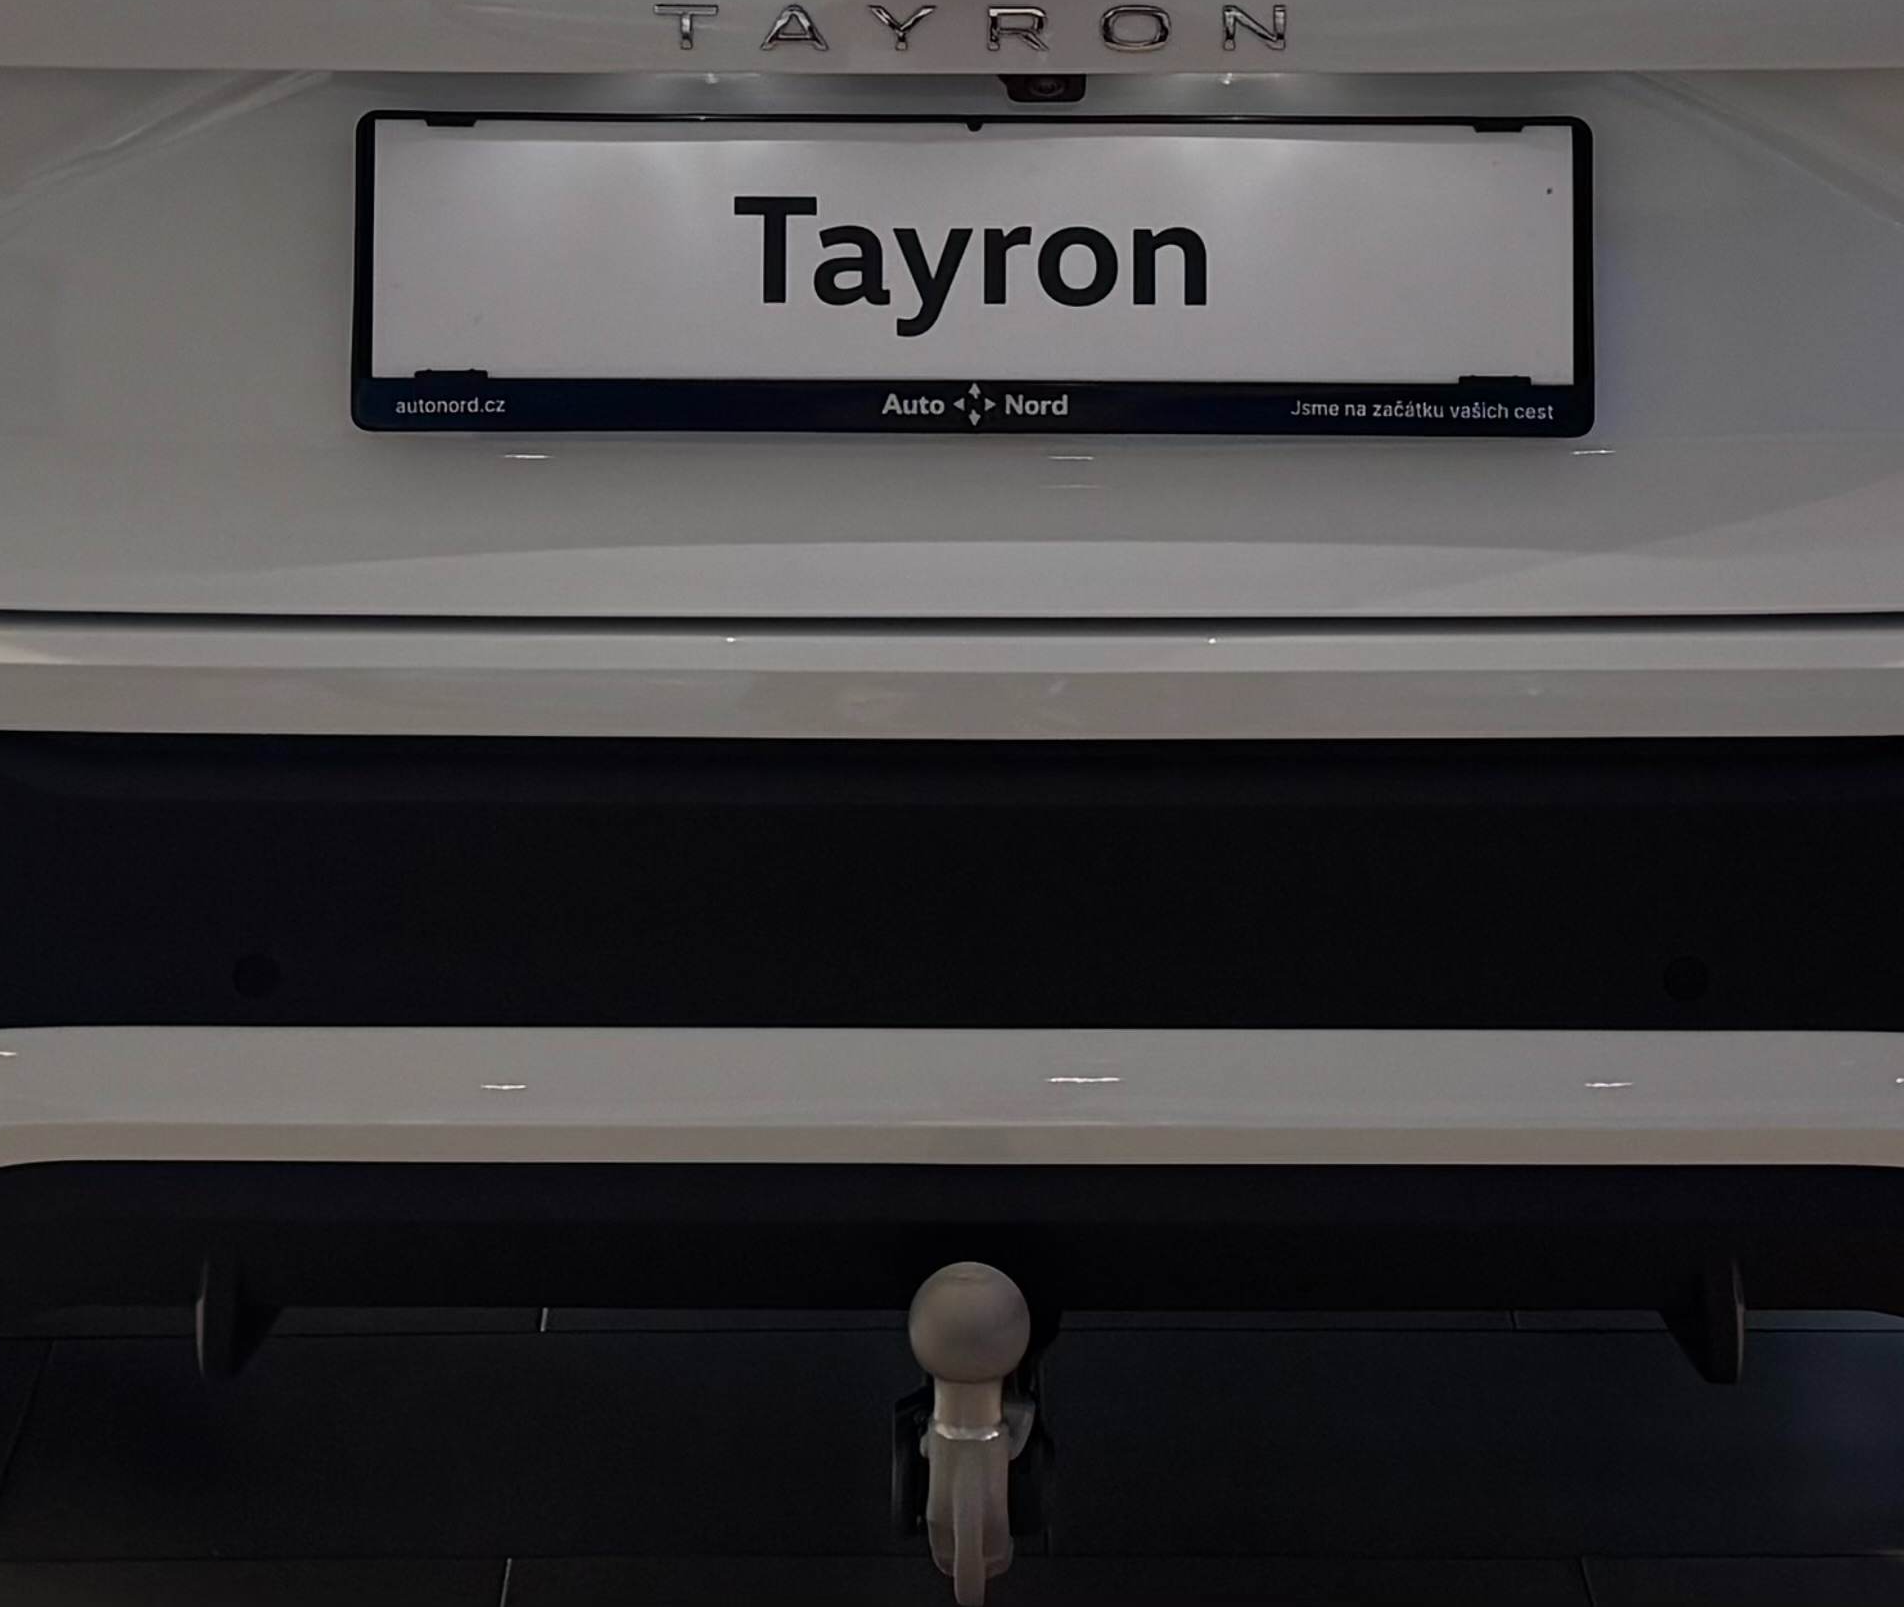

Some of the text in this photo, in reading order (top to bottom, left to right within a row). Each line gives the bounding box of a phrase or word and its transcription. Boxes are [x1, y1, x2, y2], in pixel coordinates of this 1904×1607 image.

[653, 3, 1288, 52] TAYRON
[734, 196, 1207, 337] Tayron
[395, 396, 506, 414] autonord.cz
[881, 393, 1069, 416] Auto Nord
[1290, 399, 1555, 420] Jsme na začátku vašich cest
